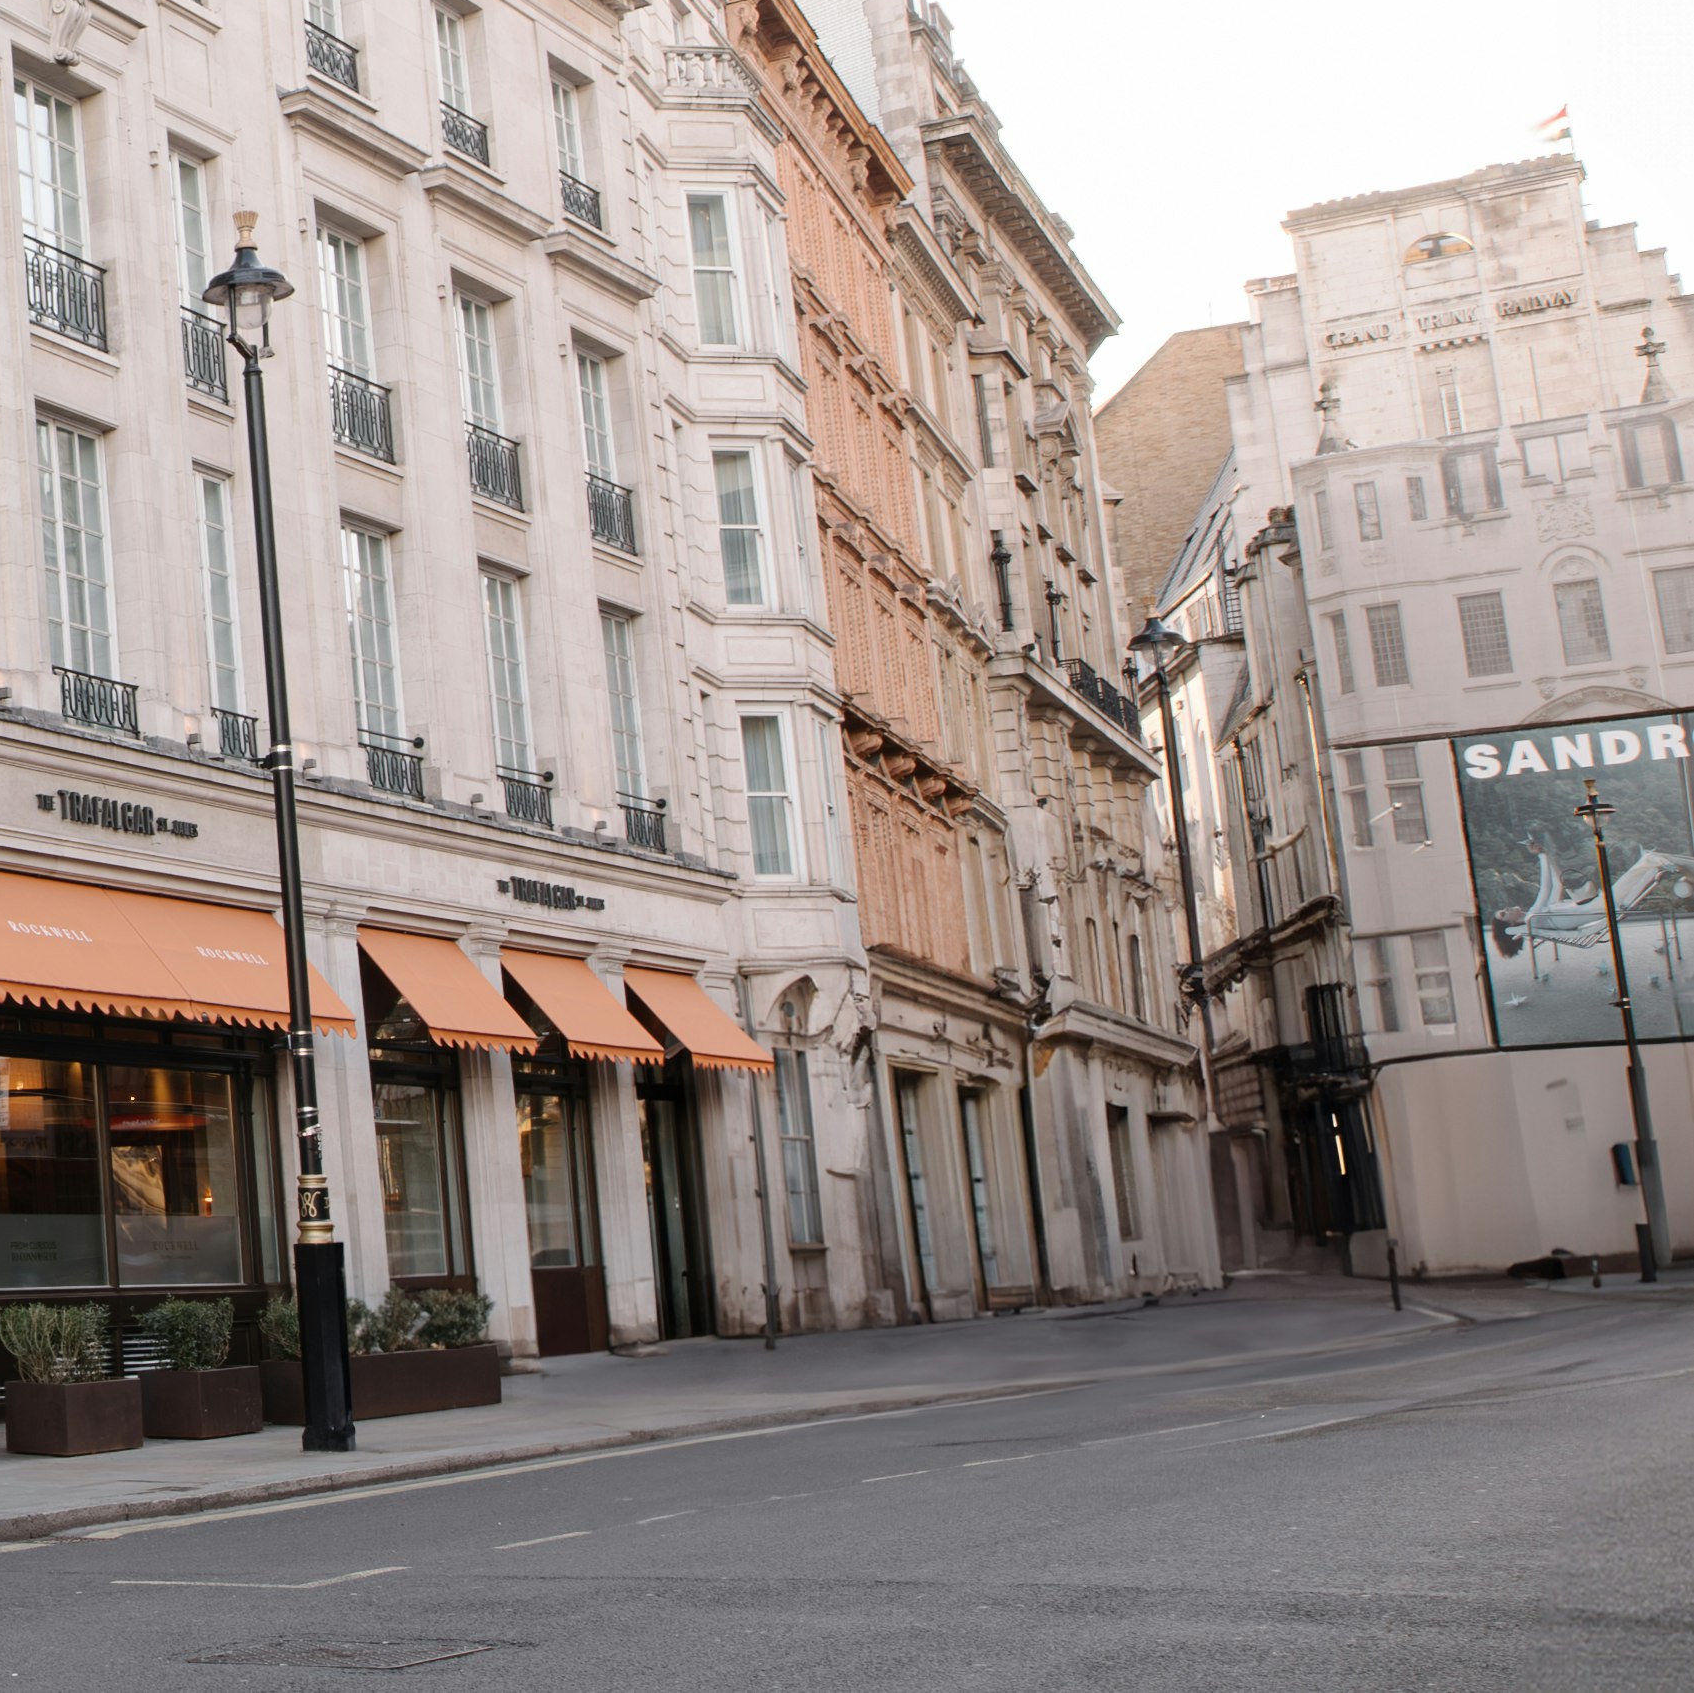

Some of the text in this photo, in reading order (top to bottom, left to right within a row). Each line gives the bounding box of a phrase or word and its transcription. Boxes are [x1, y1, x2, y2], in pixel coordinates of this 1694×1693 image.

[1323, 287, 1582, 349] GRAND TRUNK RAILWAY
[1463, 724, 1694, 779] SANDR
[35, 793, 56, 811] THE
[56, 789, 156, 836] TRAFALGAR
[509, 876, 577, 910] TRAFALGAR
[6, 919, 93, 943] ROCKWELL
[195, 945, 270, 966] ROCKWELL
